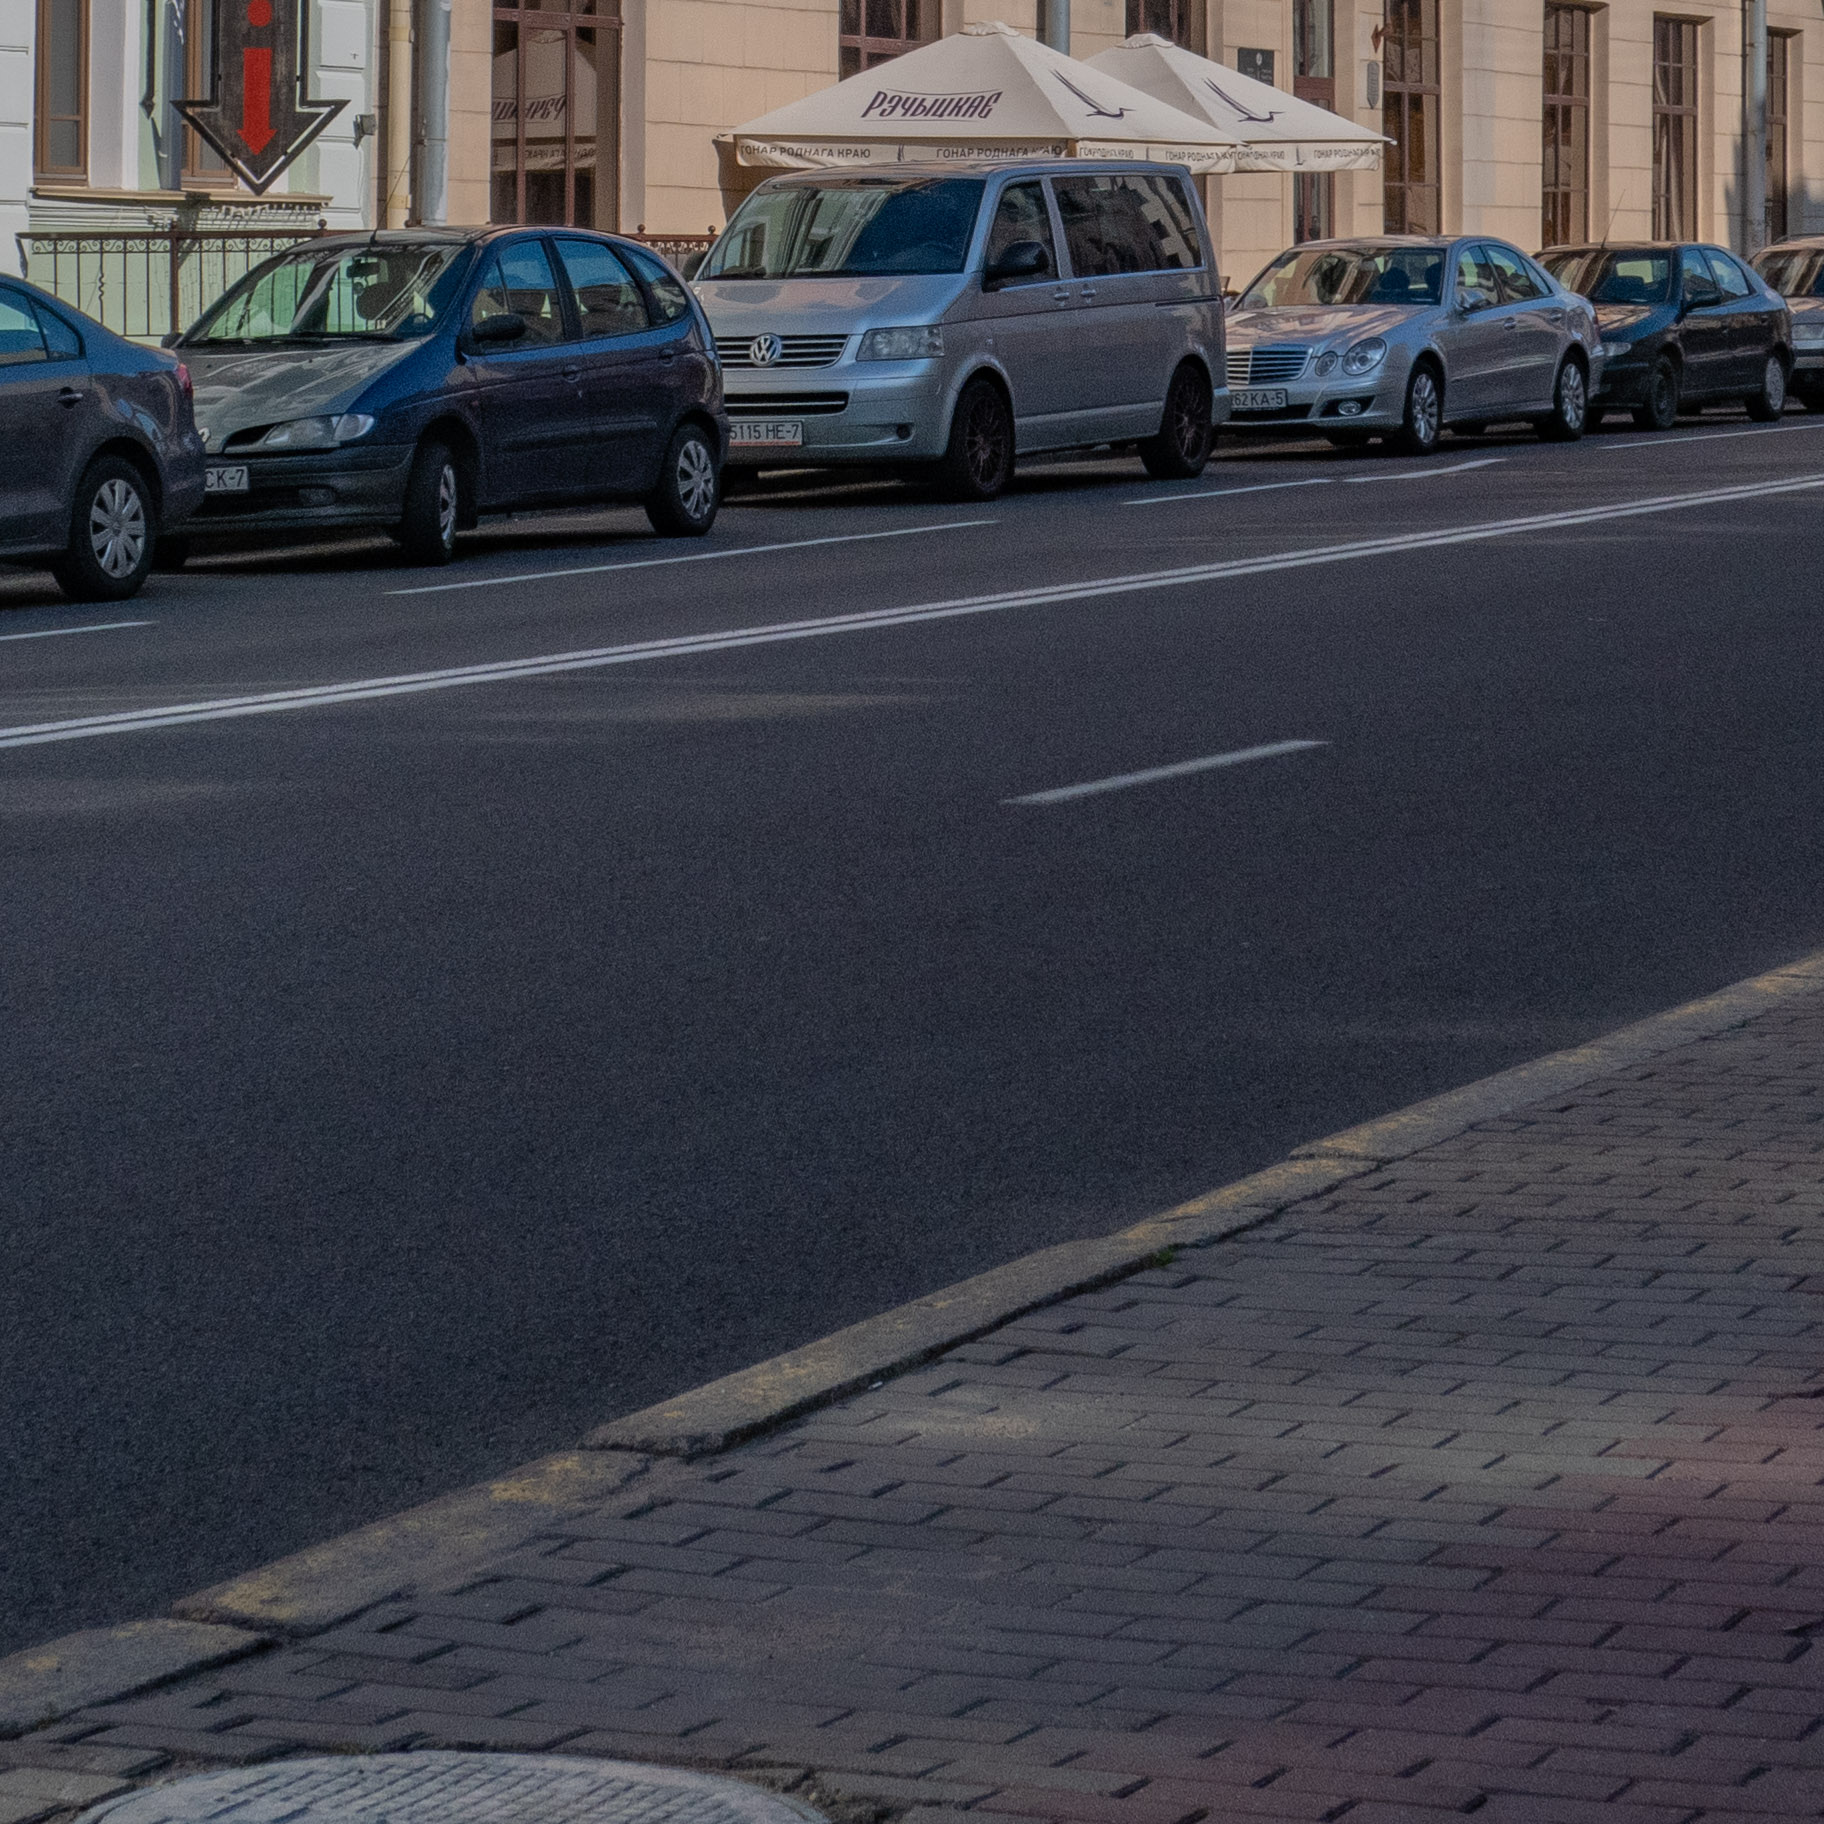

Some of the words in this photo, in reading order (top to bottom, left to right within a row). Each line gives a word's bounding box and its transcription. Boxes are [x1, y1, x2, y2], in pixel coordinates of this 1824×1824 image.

[741, 145, 777, 155] ГОНАР
[780, 146, 834, 158] РОДНАГА
[838, 148, 871, 158] КРАЮ
[936, 148, 975, 158] ГОНАР
[977, 147, 1028, 159] РОДНАГА
[1251, 391, 1283, 406] KA-5
[730, 424, 761, 439] 5115
[766, 424, 799, 439] HE-7
[206, 469, 244, 488] CK-7
